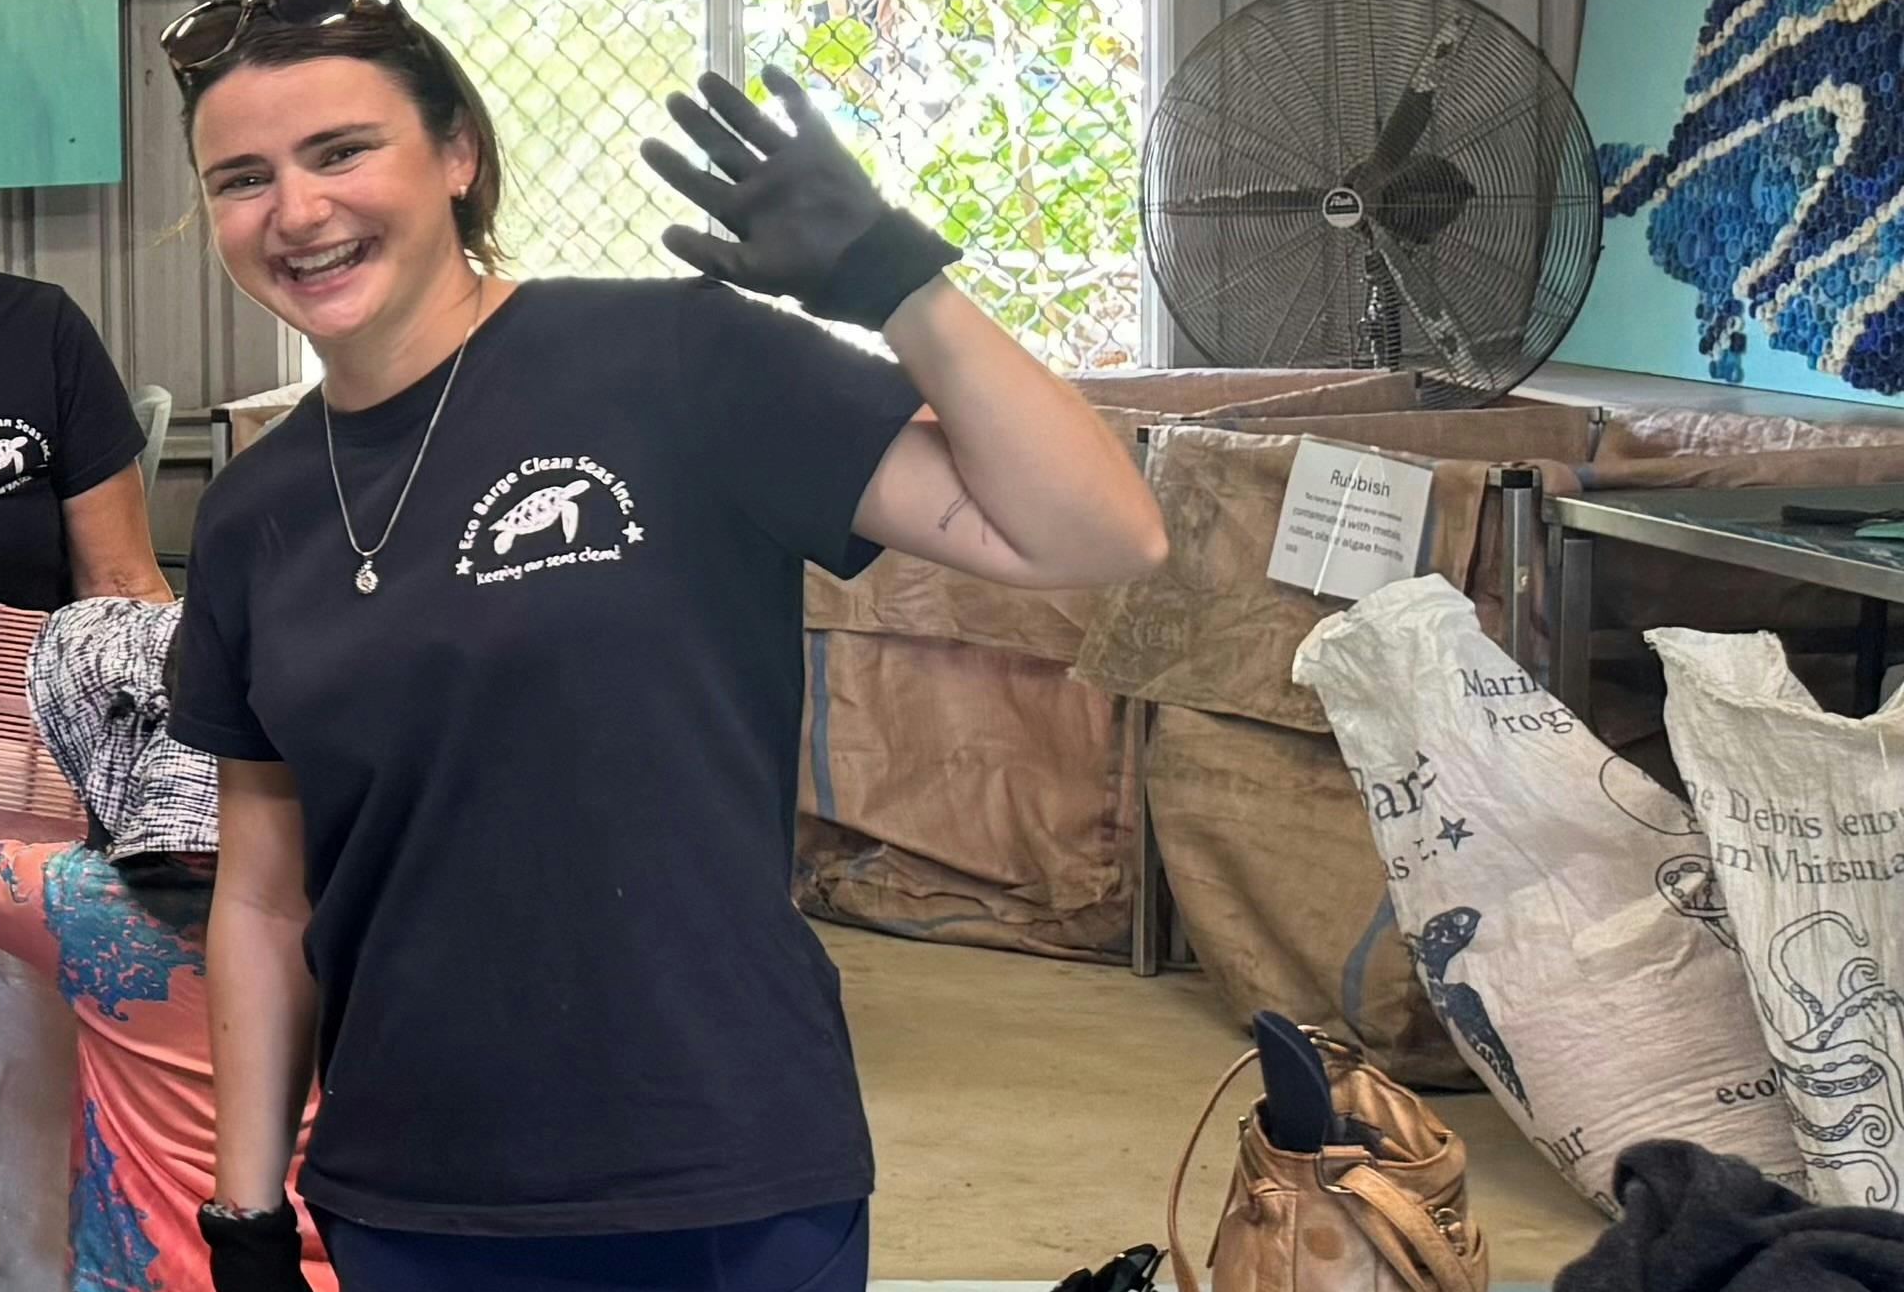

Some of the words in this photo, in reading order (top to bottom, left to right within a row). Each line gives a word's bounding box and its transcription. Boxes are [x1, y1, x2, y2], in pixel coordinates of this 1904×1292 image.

[14, 418, 43, 441] Seas
[458, 518, 481, 551] Eco
[472, 471, 520, 516] Barge
[519, 456, 574, 476] Clean
[575, 455, 617, 486] Seas
[610, 480, 636, 516] Inc.
